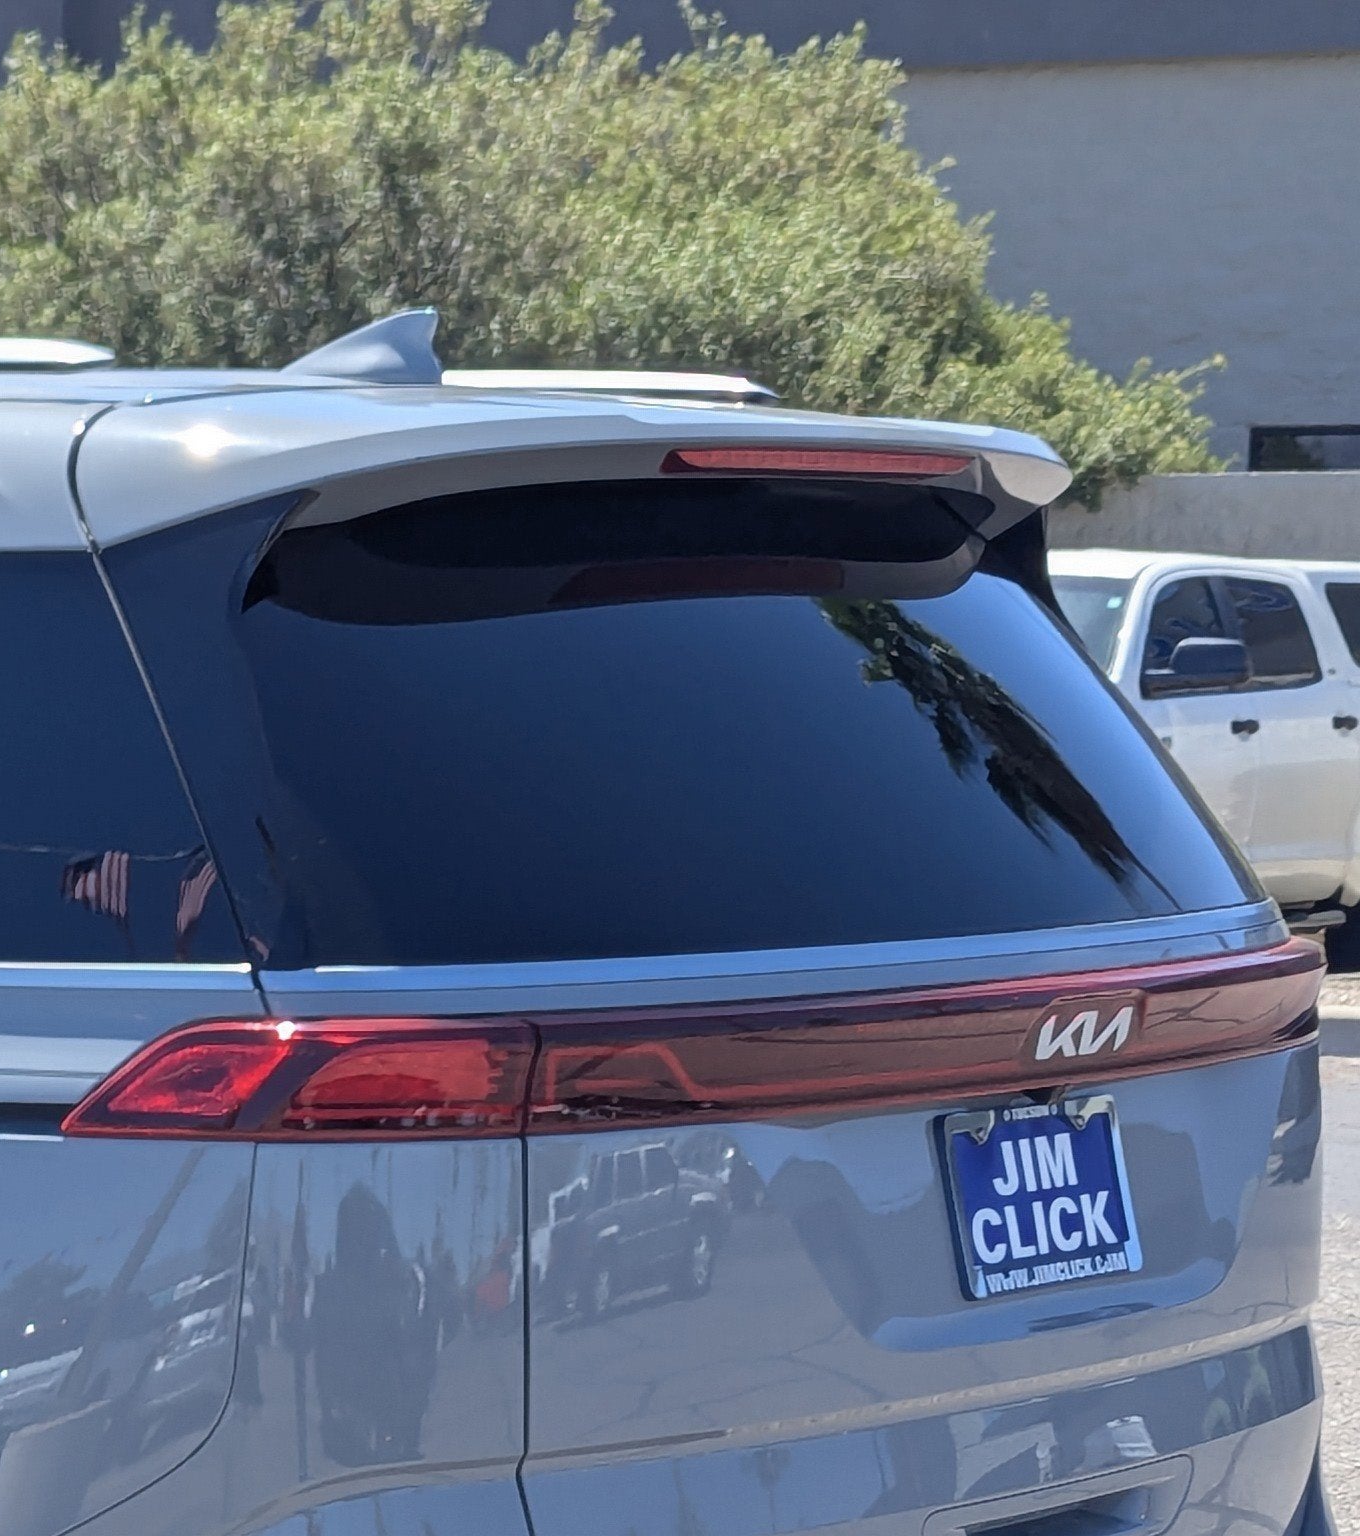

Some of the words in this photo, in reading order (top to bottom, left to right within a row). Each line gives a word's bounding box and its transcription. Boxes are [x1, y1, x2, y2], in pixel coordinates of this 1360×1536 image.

[1035, 1006, 1133, 1060] KIA
[992, 1133, 1079, 1196] JIM
[972, 1190, 1119, 1265] CLICK
